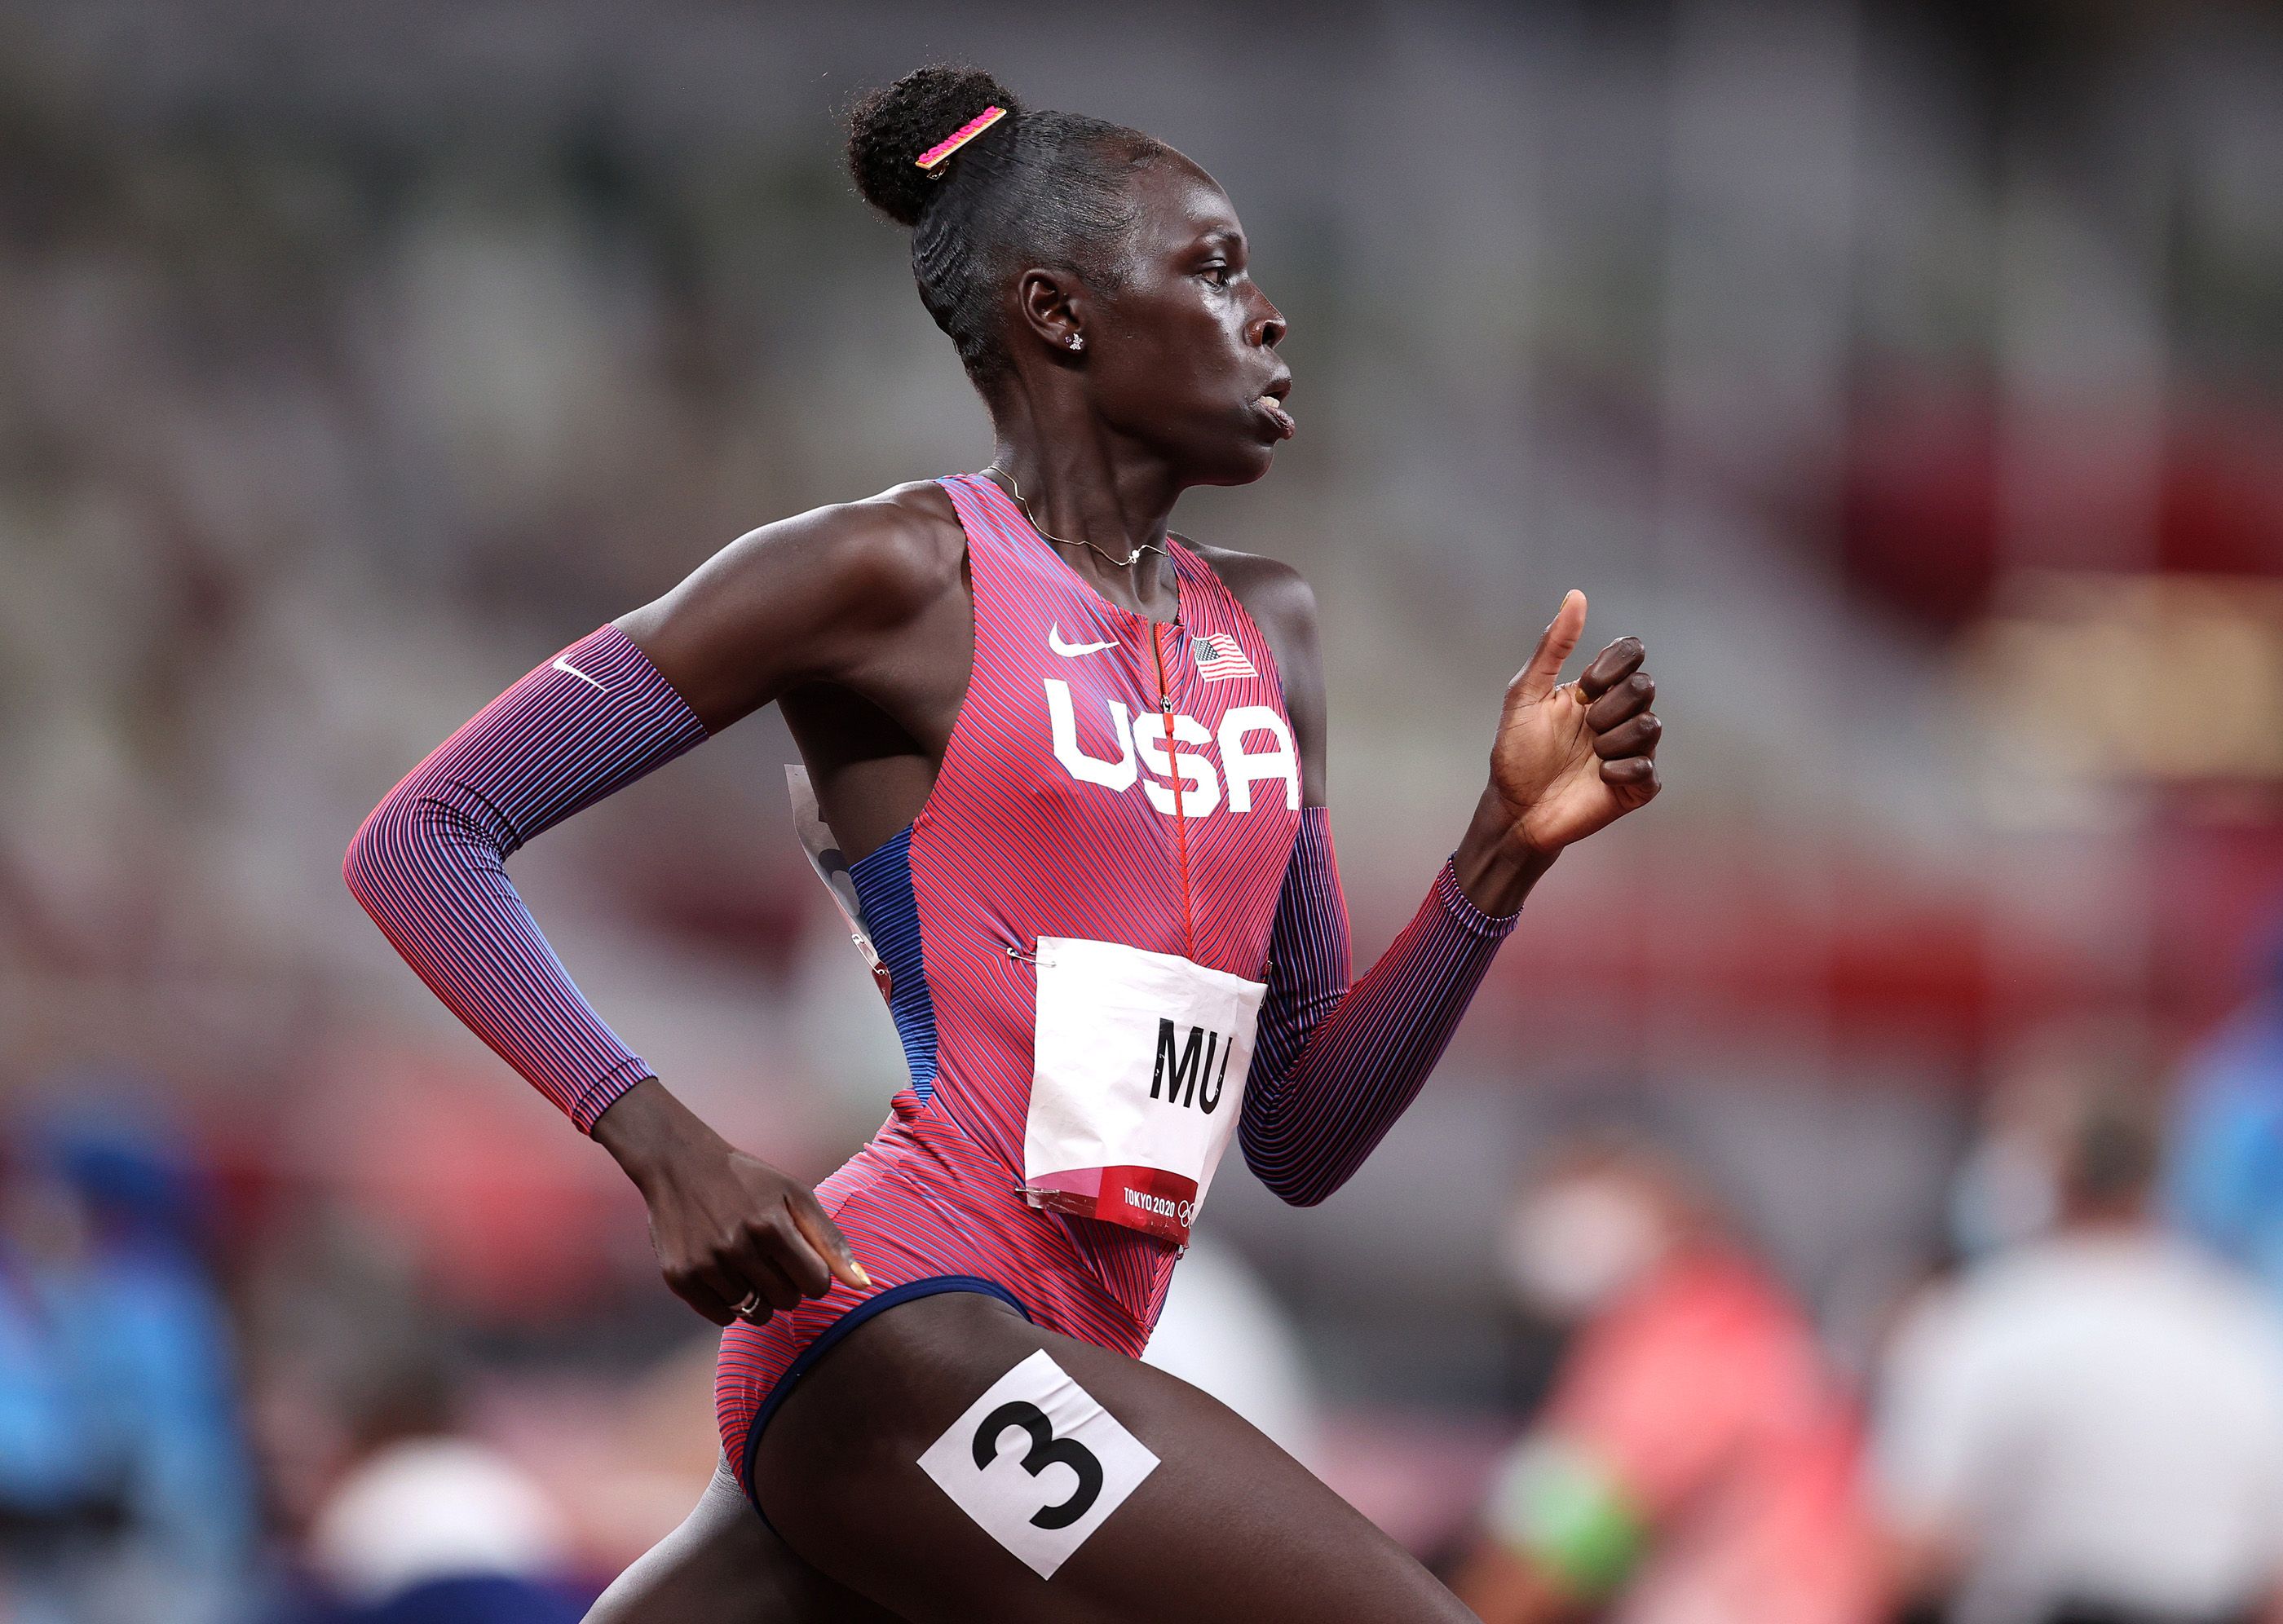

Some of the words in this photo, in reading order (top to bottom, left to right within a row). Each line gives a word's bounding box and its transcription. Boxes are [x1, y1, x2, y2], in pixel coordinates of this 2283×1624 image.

[1044, 678, 1300, 818] USA
[1150, 1017, 1232, 1114] MU
[1124, 1187, 1152, 1211] TOKYO
[1153, 1197, 1175, 1217] 2020
[972, 1401, 1103, 1529] 3
